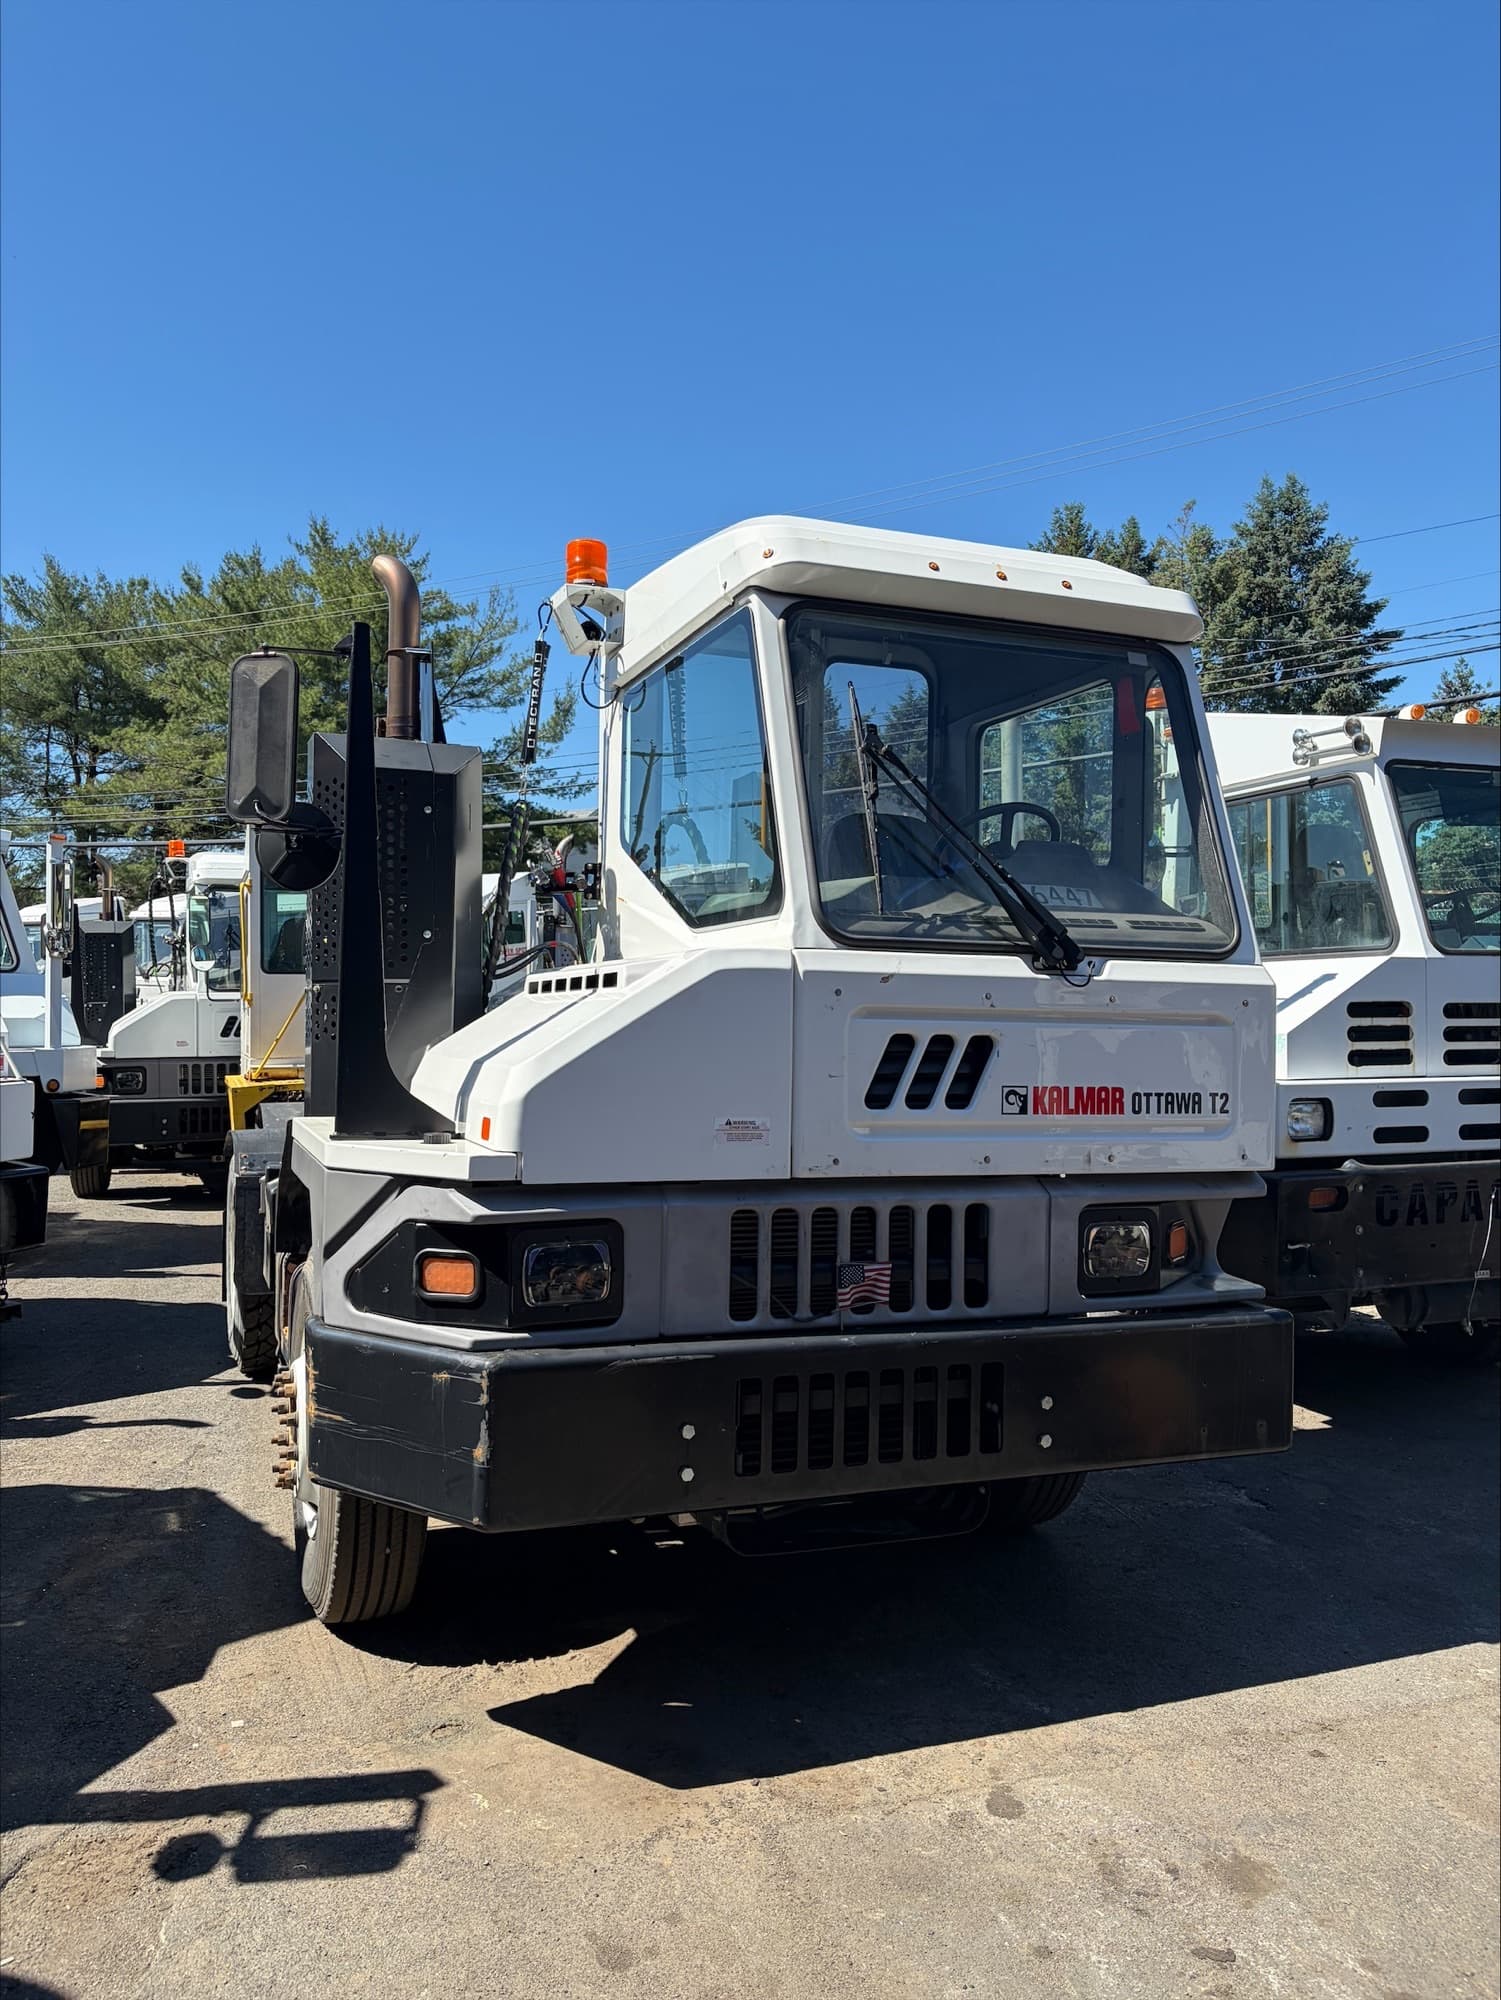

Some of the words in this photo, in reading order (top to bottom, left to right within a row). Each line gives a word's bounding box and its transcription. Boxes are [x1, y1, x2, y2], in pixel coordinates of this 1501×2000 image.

[528, 667, 542, 735] TECTRAN
[1032, 1085, 1125, 1116] KALMAR
[1131, 1091, 1202, 1115] OTTAWA
[1208, 1091, 1230, 1115] T2
